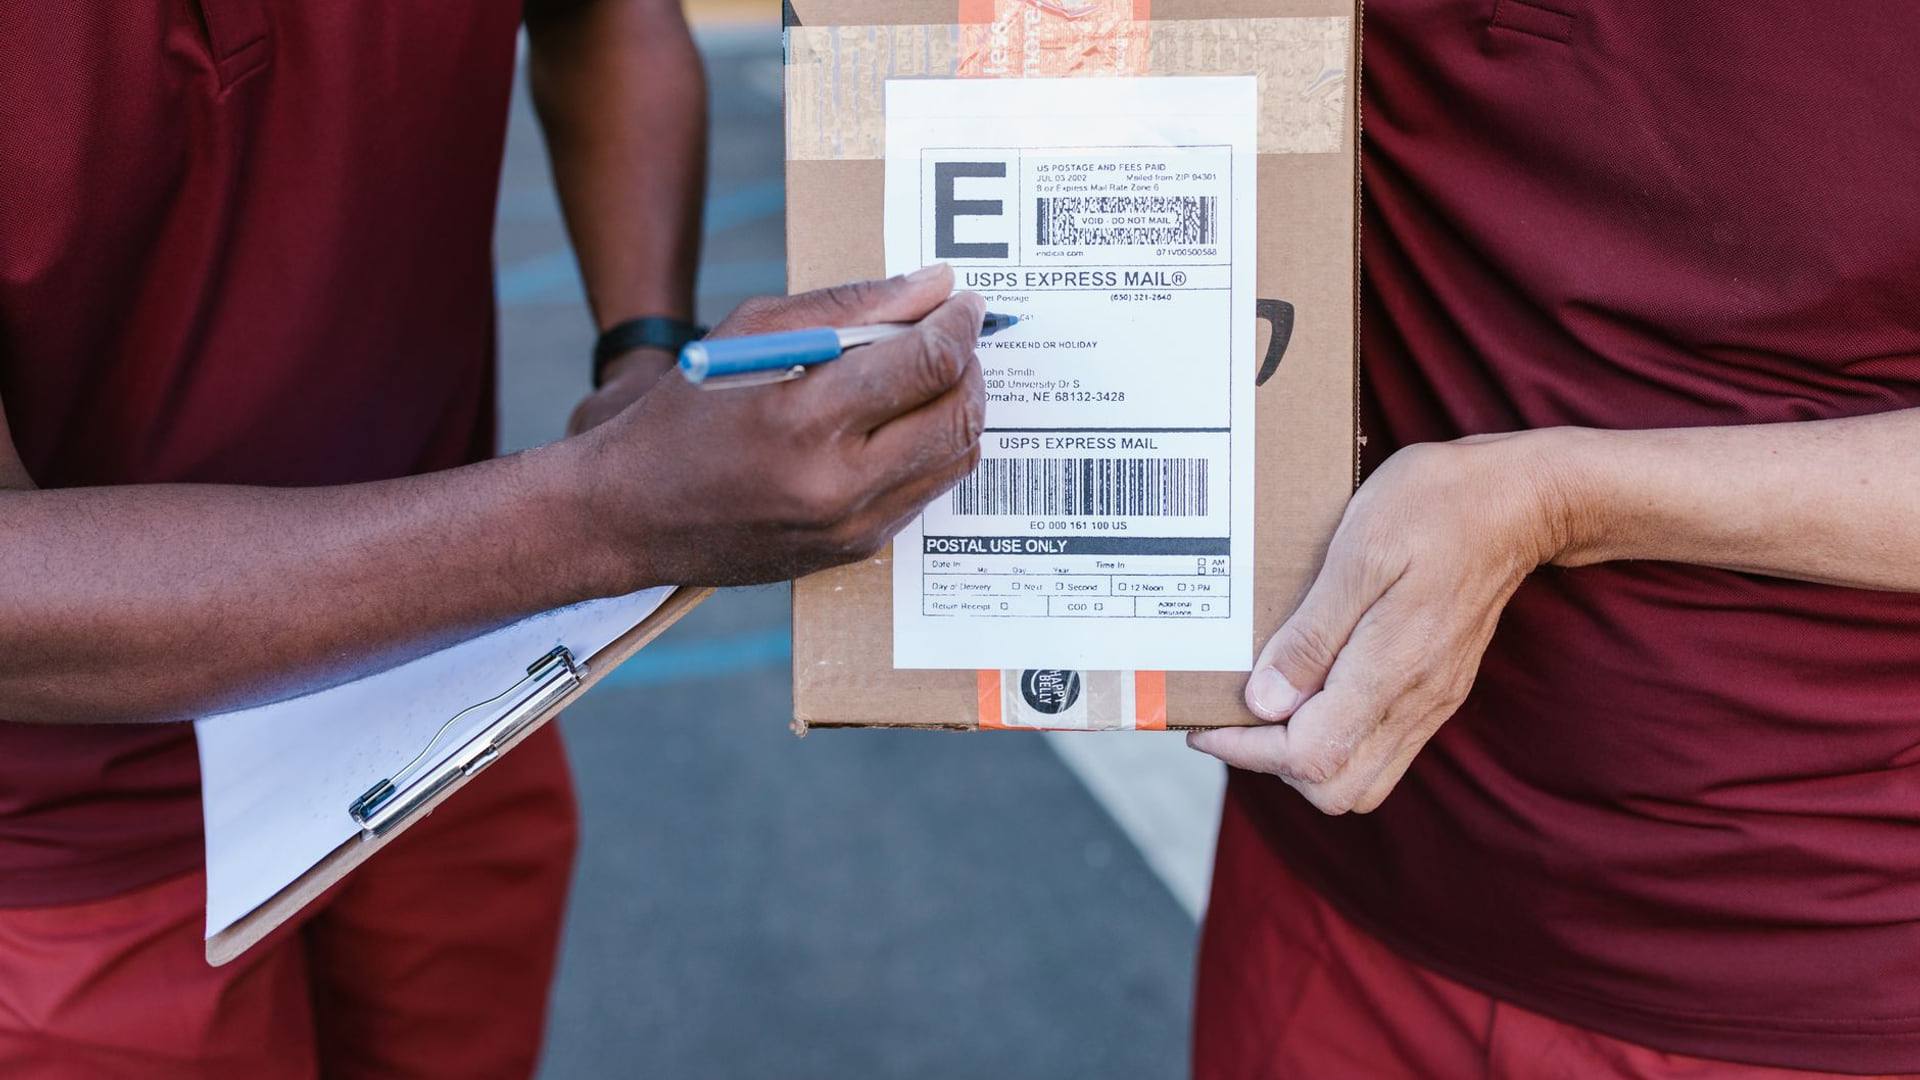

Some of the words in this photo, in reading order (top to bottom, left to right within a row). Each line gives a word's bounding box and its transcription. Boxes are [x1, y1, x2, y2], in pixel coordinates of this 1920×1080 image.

[1036, 164, 1049, 172] US
[1052, 164, 1094, 172] POSTAGE
[1145, 163, 1166, 171] PAID
[1176, 173, 1190, 181] ZIP
[1056, 184, 1088, 193] Express
[1090, 184, 1107, 192] Mail
[1109, 184, 1128, 192] Rate
[935, 162, 1009, 258] E
[966, 272, 1017, 287] USPS
[1025, 272, 1117, 287] EXPRESS
[997, 295, 1029, 303] Postage
[1007, 368, 1035, 376] Smith
[1008, 379, 1056, 390] University
[1059, 380, 1071, 388] Dr
[1074, 380, 1080, 388] S
[1033, 392, 1050, 401] NE
[1055, 391, 1125, 401] 68132-3428
[1000, 438, 1040, 449] USPS
[1045, 437, 1116, 449] EXPRESS
[1121, 438, 1158, 449] MAIL
[1048, 521, 1067, 530] 000
[1092, 521, 1109, 530] 100
[1112, 521, 1127, 530] US
[926, 539, 987, 552] POSTAL
[990, 539, 1022, 552] USE
[1025, 539, 1067, 553] ONLY
[1038, 675, 1052, 704] BELLY
[1049, 669, 1066, 703] HAPPY
